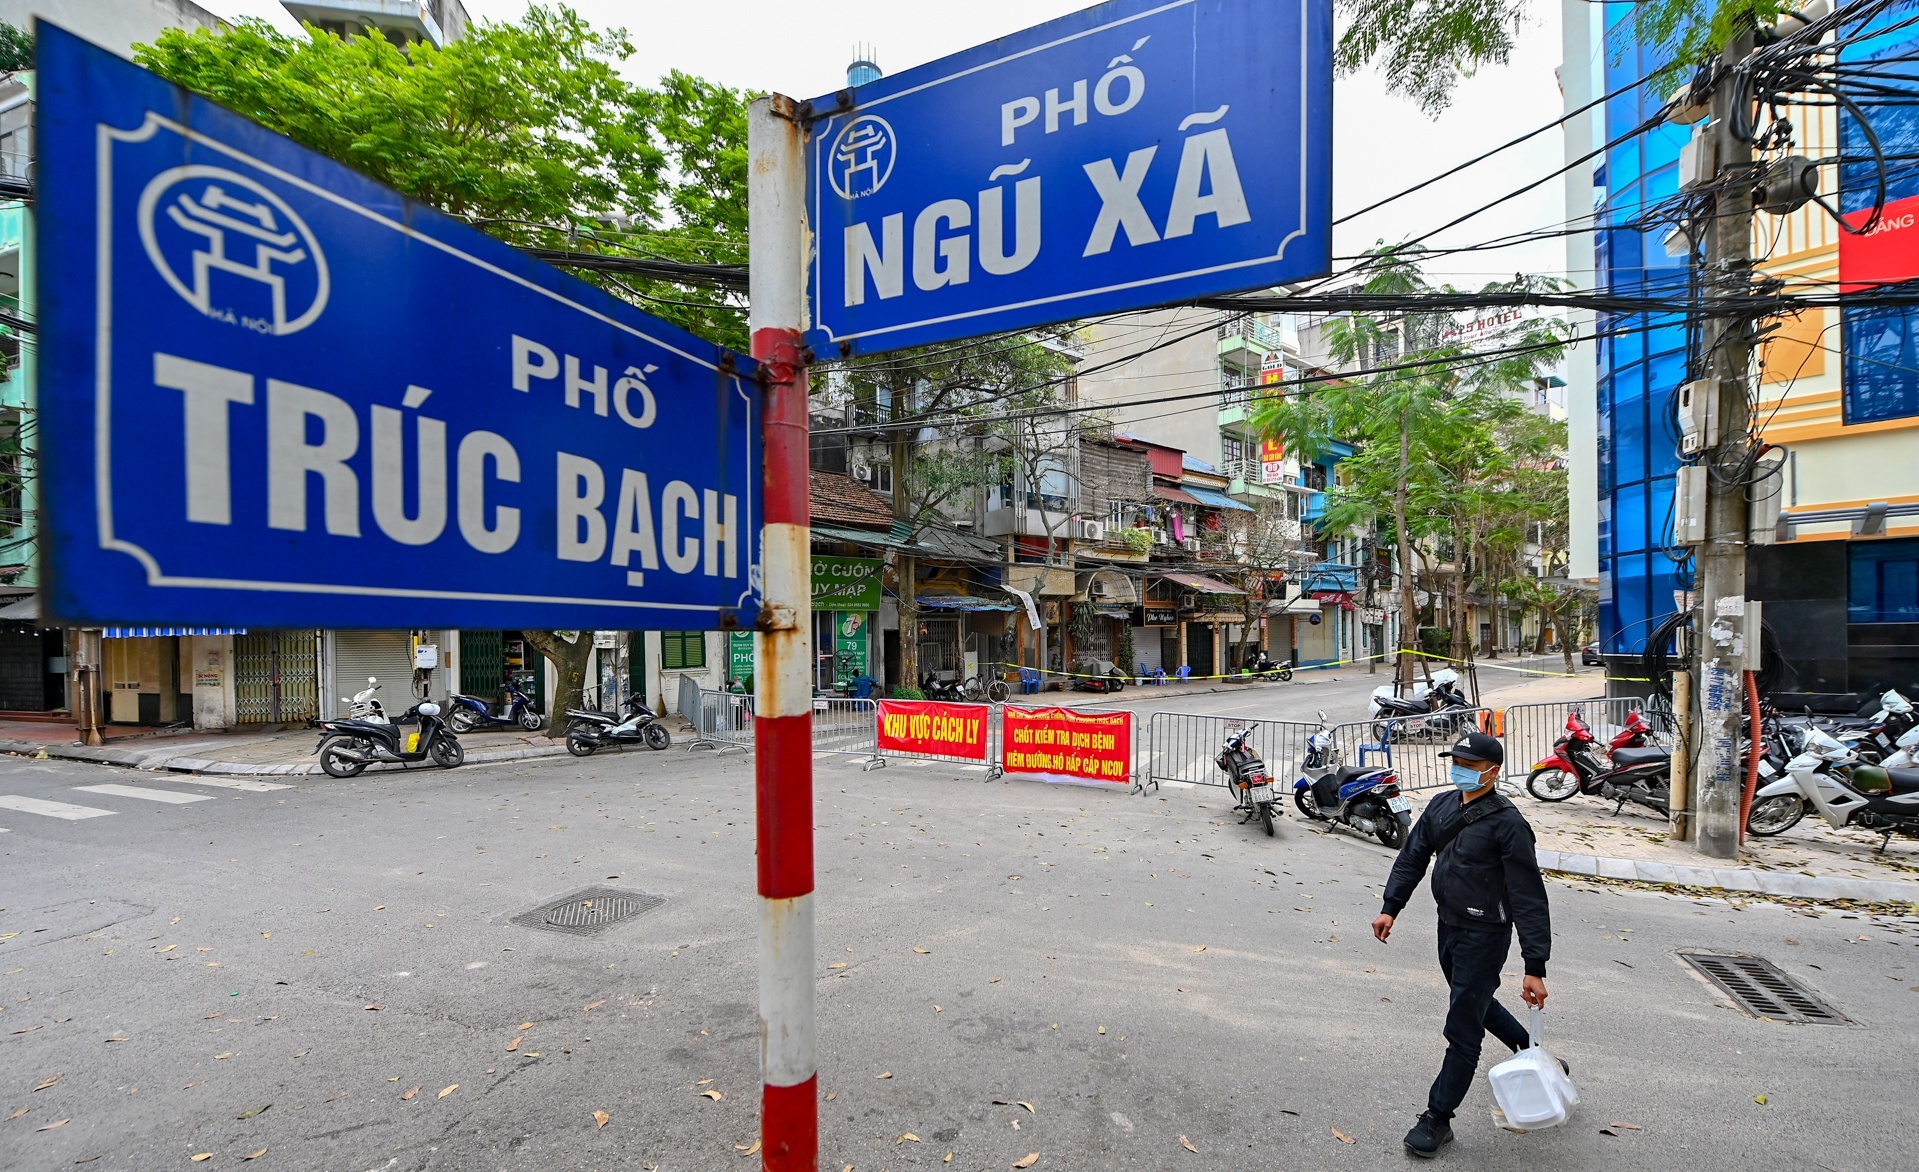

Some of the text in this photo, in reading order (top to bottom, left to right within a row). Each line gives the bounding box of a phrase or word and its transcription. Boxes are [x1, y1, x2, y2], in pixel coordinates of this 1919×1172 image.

[1001, 34, 1151, 147] PHỐ
[843, 104, 1252, 308] NGŨ XÃ
[1477, 309, 1522, 331] HOTEL
[1262, 362, 1283, 371] GOLD
[510, 334, 660, 430] PHỐ
[153, 352, 738, 588] TRÚC BẠCH
[1267, 463, 1278, 472] 89
[846, 641, 857, 651] 79
[884, 711, 979, 745] KHU VỰC CÁCH LY
[1013, 723, 1115, 753] CHỐT KIỂM TRA DỊCH BỆNH
[1006, 749, 1124, 777] VIÊM ĐƯỜNG HÔ HẤP CẤP NCOV
